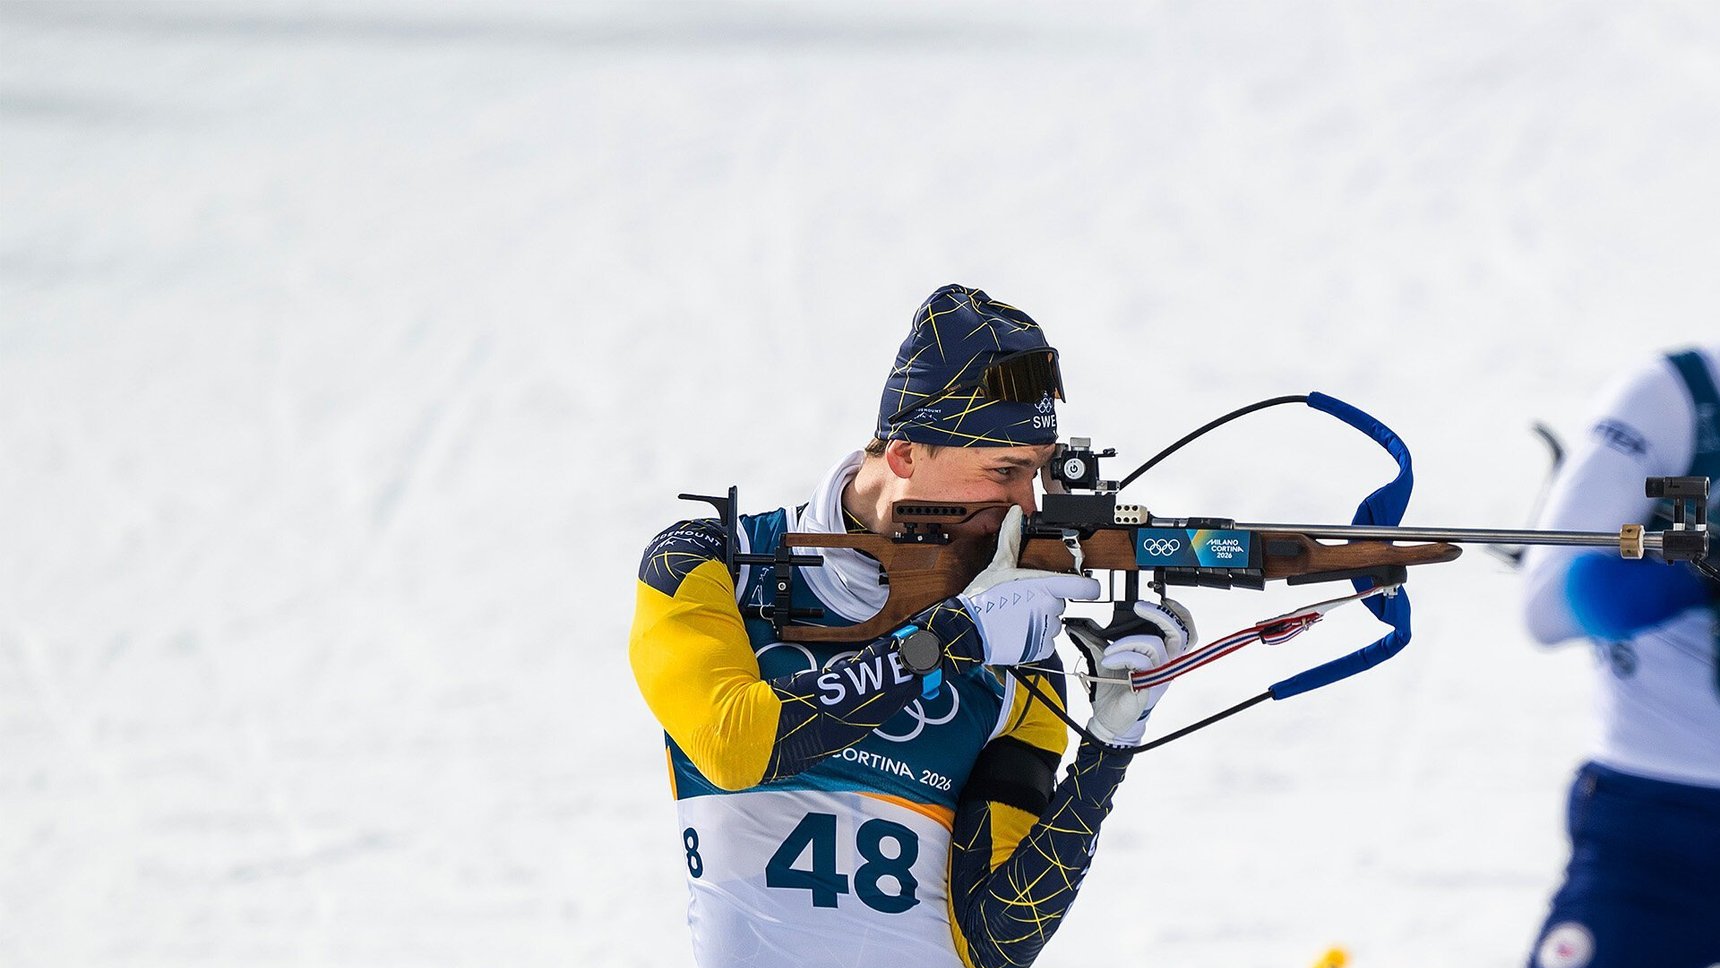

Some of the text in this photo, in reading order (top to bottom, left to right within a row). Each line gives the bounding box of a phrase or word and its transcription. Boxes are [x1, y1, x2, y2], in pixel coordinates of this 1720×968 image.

[1032, 414, 1057, 430] SWE
[1211, 545, 1244, 553] CORTINA
[816, 651, 914, 706] SWE
[919, 769, 952, 791] 2026
[765, 812, 921, 914] 48
